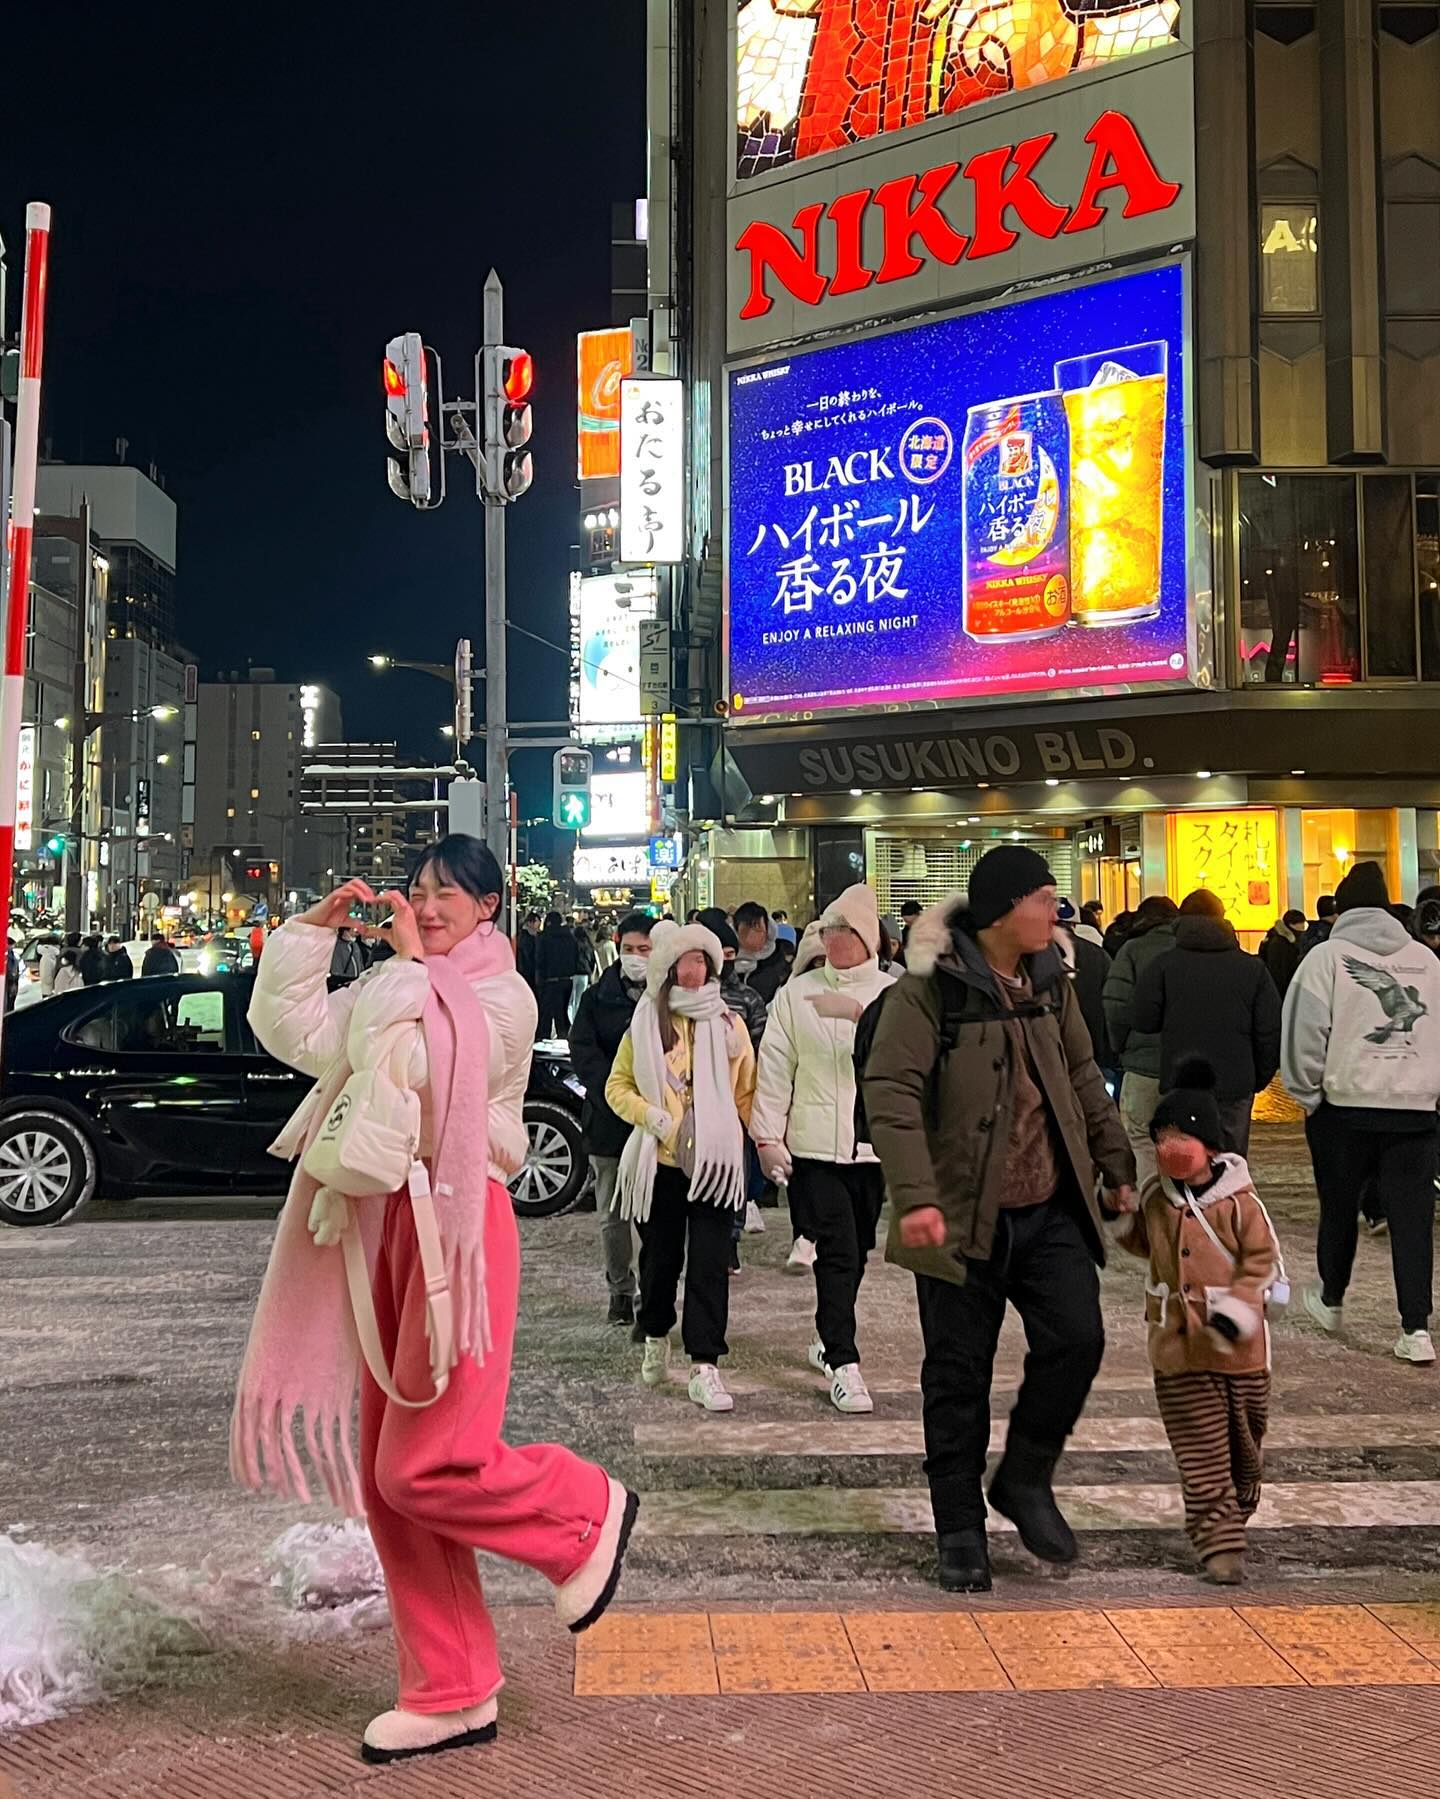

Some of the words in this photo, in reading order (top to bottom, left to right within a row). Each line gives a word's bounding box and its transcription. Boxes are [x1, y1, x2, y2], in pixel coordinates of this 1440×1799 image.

[735, 109, 1182, 320] NIKKA
[636, 354, 648, 371] 2
[806, 388, 882, 411] 一日の終わりを、
[761, 400, 923, 440] ちょっと幸せにしてくれるハイボール。
[908, 434, 946, 451] 北海道
[784, 446, 895, 496] BLACK
[999, 477, 1034, 491] BLACK
[747, 494, 935, 556] ハイボール
[987, 511, 1047, 541] 香る夜
[771, 541, 908, 615] 香る夜
[762, 629, 800, 645] ENJOY
[803, 628, 812, 640] A
[815, 620, 875, 638] RELAXING
[879, 615, 918, 631] NIGHT
[800, 733, 1021, 784] SUSUKINO
[1034, 729, 1154, 773] BLD.
